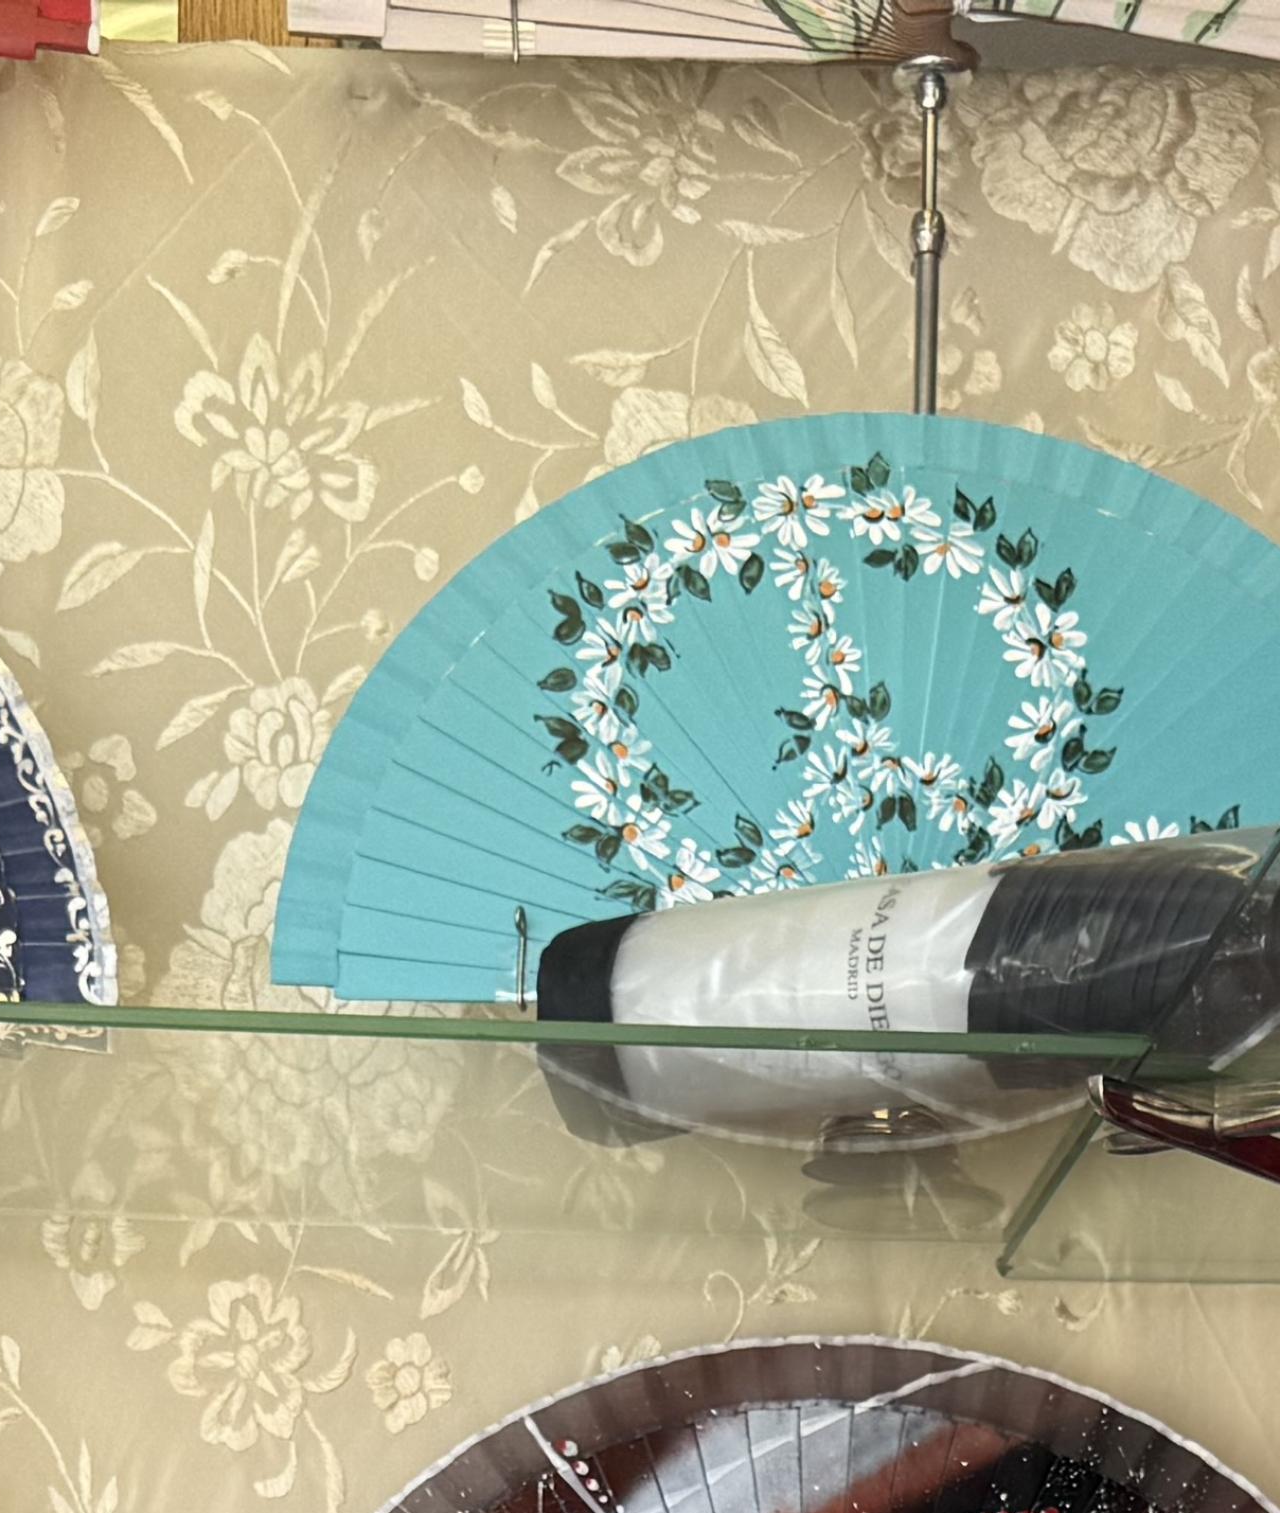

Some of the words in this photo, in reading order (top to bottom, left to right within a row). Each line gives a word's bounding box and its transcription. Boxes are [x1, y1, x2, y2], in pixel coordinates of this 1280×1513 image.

[871, 884, 902, 930] ASA
[847, 928, 863, 1000] MADRID
[865, 934, 887, 974] DE
